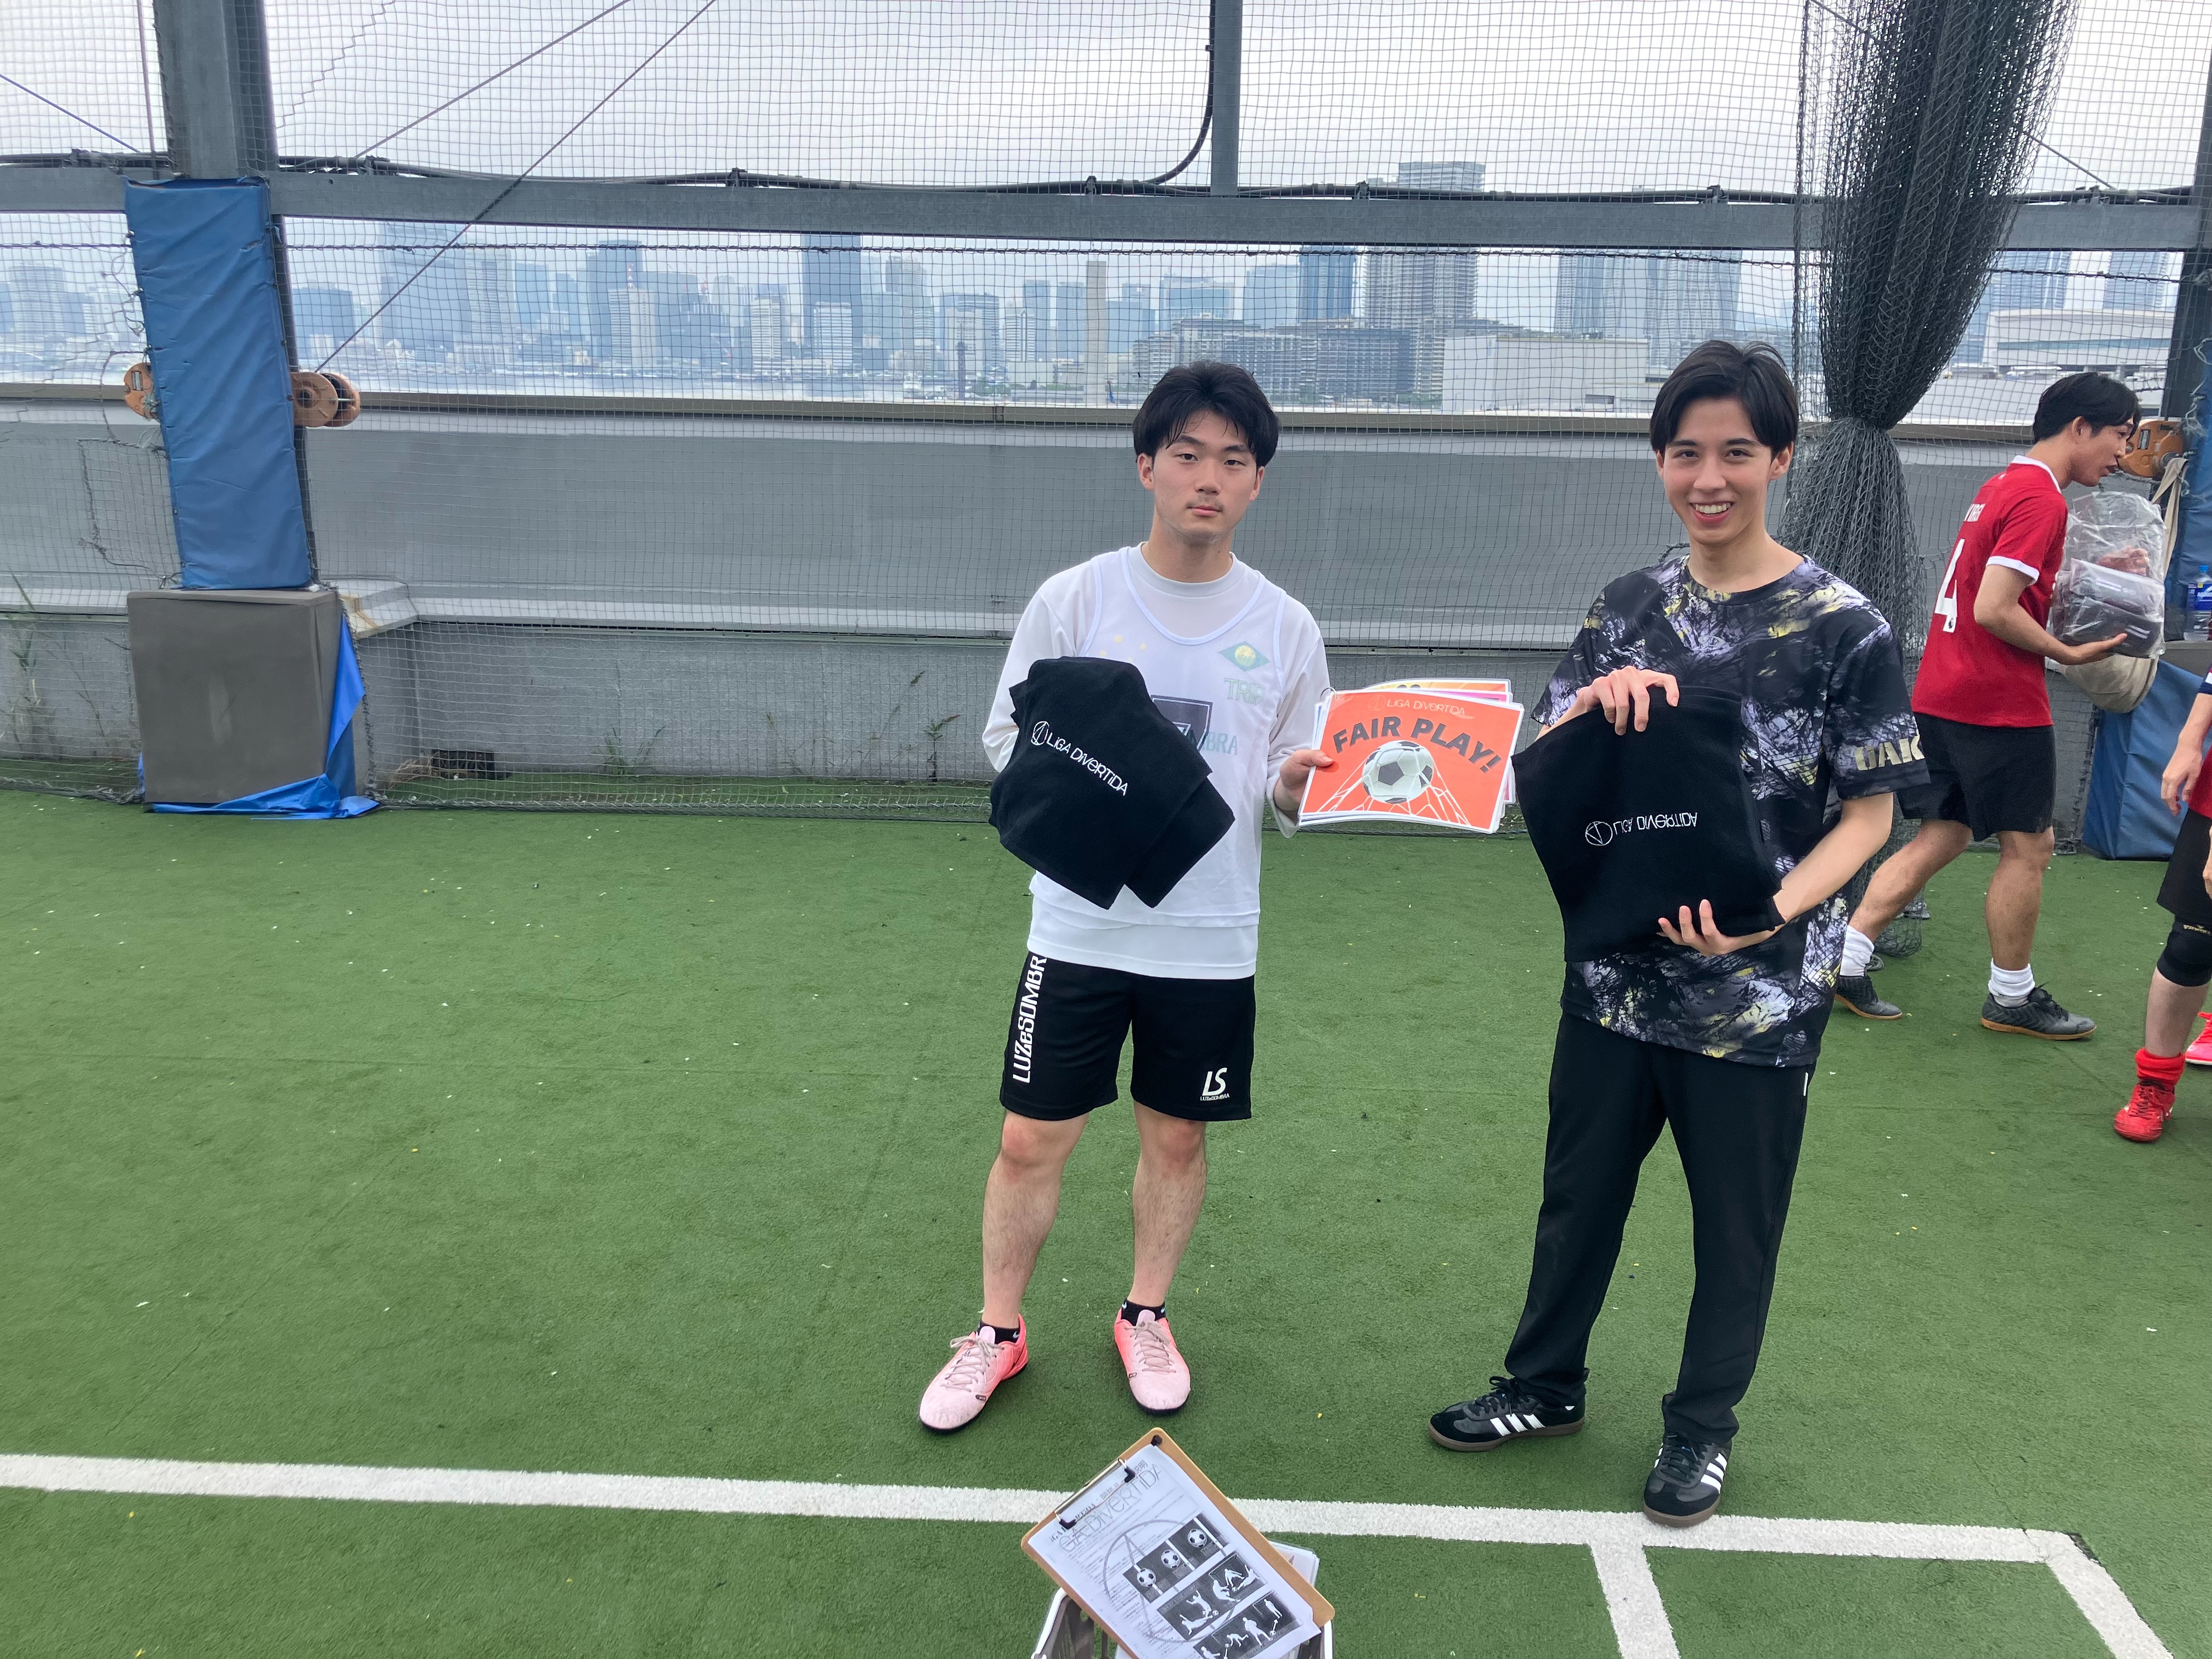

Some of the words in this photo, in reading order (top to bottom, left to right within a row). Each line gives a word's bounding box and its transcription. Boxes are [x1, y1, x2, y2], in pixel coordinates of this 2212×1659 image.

[1934, 538, 1965, 633] 4
[1333, 716, 1402, 754] FAIR
[1410, 718, 1502, 774] PLAY!
[1012, 955, 1048, 1084] LUZeSOMBR
